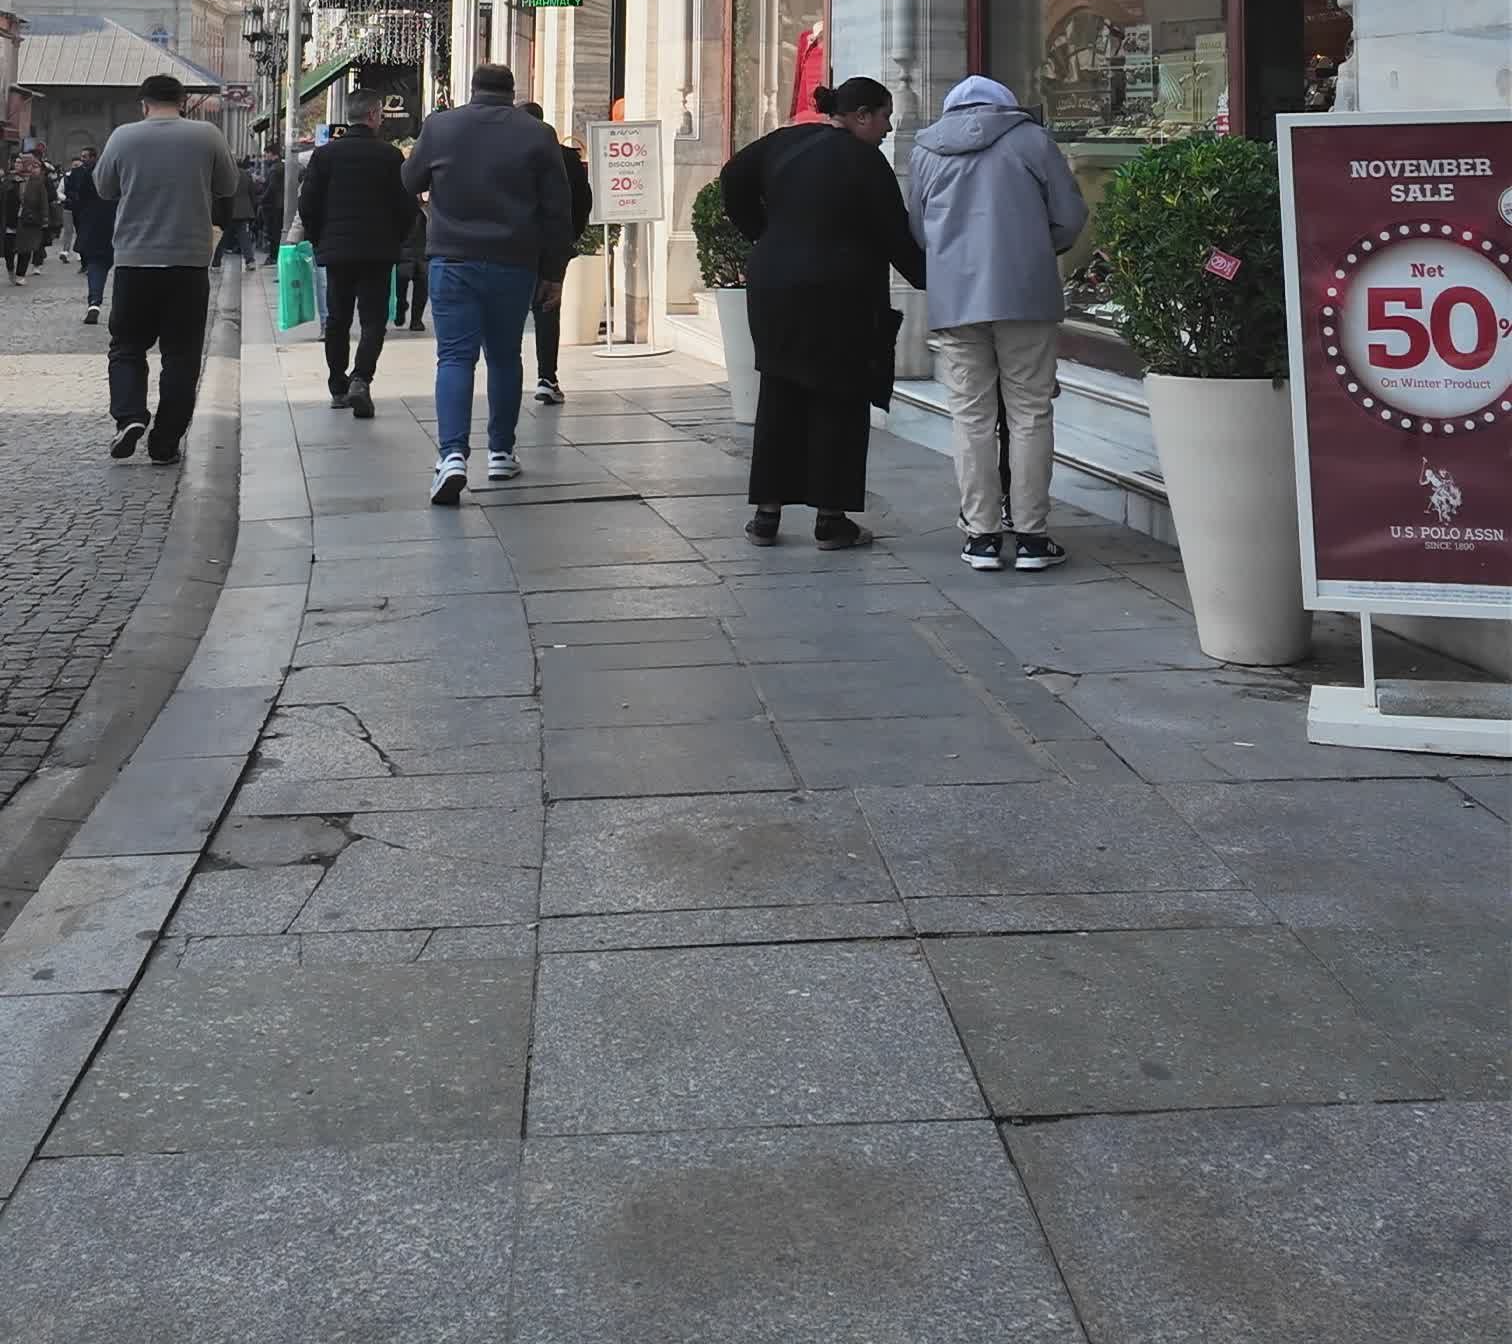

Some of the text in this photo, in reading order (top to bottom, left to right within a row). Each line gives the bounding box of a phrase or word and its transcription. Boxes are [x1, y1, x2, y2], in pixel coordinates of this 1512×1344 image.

[609, 142, 647, 158] 50%
[608, 160, 645, 168] DISCOUNT
[1350, 158, 1493, 178] NOVEMBER
[610, 177, 643, 191] 20%
[1391, 184, 1454, 202] SALE
[1411, 263, 1444, 278] Net
[1380, 377, 1491, 389] On Winter Product
[1390, 526, 1418, 539] U.S.
[1421, 527, 1461, 540] POLO
[1424, 541, 1475, 551] SINCE 1890
